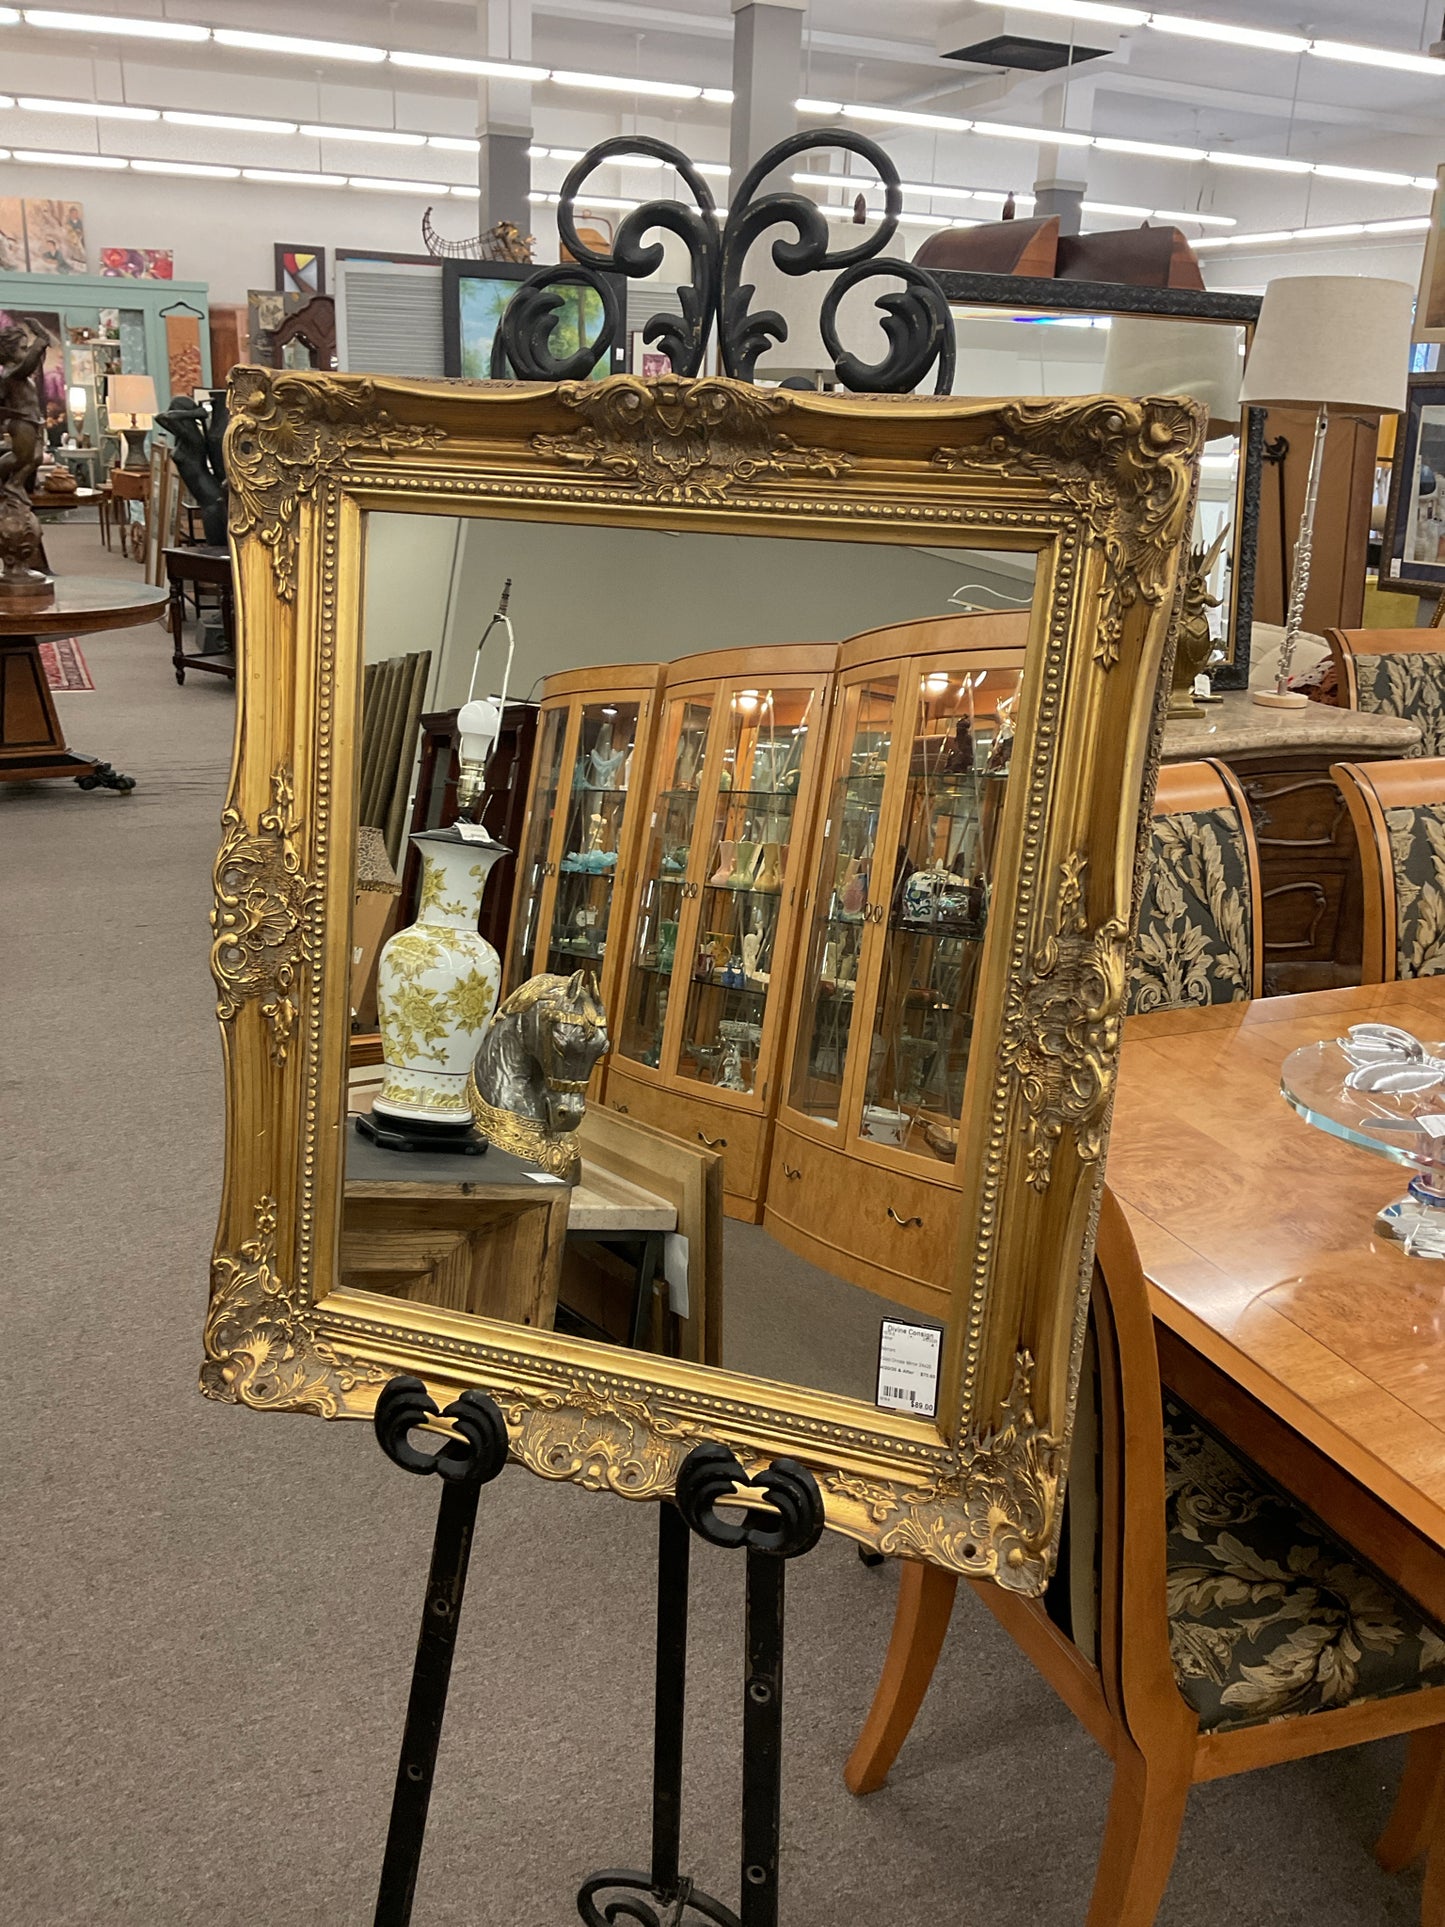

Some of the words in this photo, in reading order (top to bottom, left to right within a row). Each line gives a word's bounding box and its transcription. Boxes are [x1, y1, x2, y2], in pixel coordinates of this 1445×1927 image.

[888, 1325, 907, 1335] Divine
[908, 1328, 934, 1340] Consign
[910, 1400, 933, 1412] $89.00
